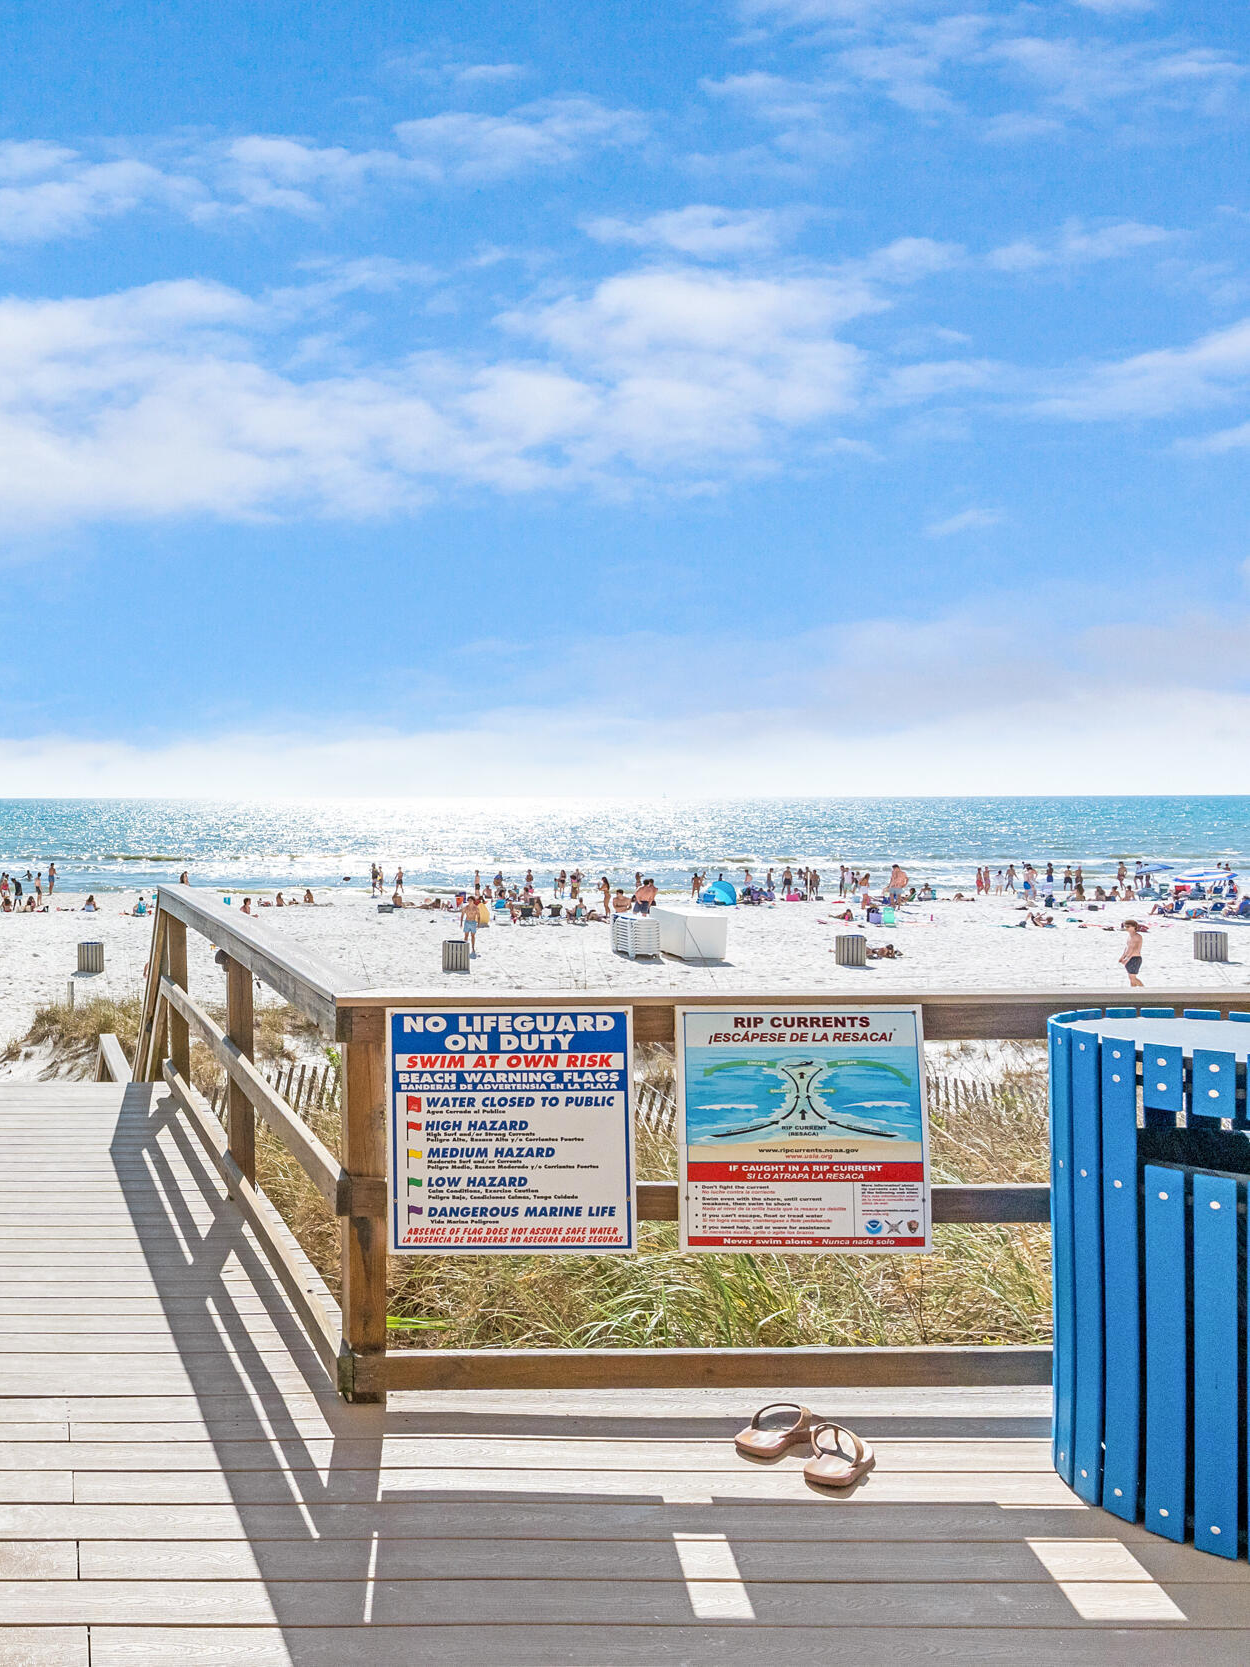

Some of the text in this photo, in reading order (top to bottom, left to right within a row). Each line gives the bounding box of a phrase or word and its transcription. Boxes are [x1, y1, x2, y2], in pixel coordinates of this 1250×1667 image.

[404, 1015, 615, 1033] NO LIFEGUARD
[733, 1016, 871, 1028] RIP CURRENTS
[444, 1033, 575, 1051] ON DUTY
[708, 1030, 893, 1044] ¡ESCÁPESE DE LA RESACA!
[406, 1054, 613, 1069] SWIM AT OWN RISK
[398, 1071, 620, 1083] BEACH WARNING FLAGS
[426, 1096, 615, 1108] WATER CLOSED TO PUBLIC
[424, 1120, 529, 1131] HIGH HAZARD
[426, 1147, 556, 1158] MEDIUM HAZARD
[427, 1176, 528, 1188] LOW HAZARD
[746, 1172, 756, 1180] SI
[427, 1206, 617, 1218] DANGEROUS MARINE LIFE
[407, 1227, 619, 1236] ABSENCE OF FLAG DOES NOT ASSURE SAFE WATER
[402, 1236, 412, 1244] LA
[412, 1236, 452, 1244] AUSENCIA
[453, 1236, 465, 1244] DE
[587, 1235, 624, 1243] SEGURAS
